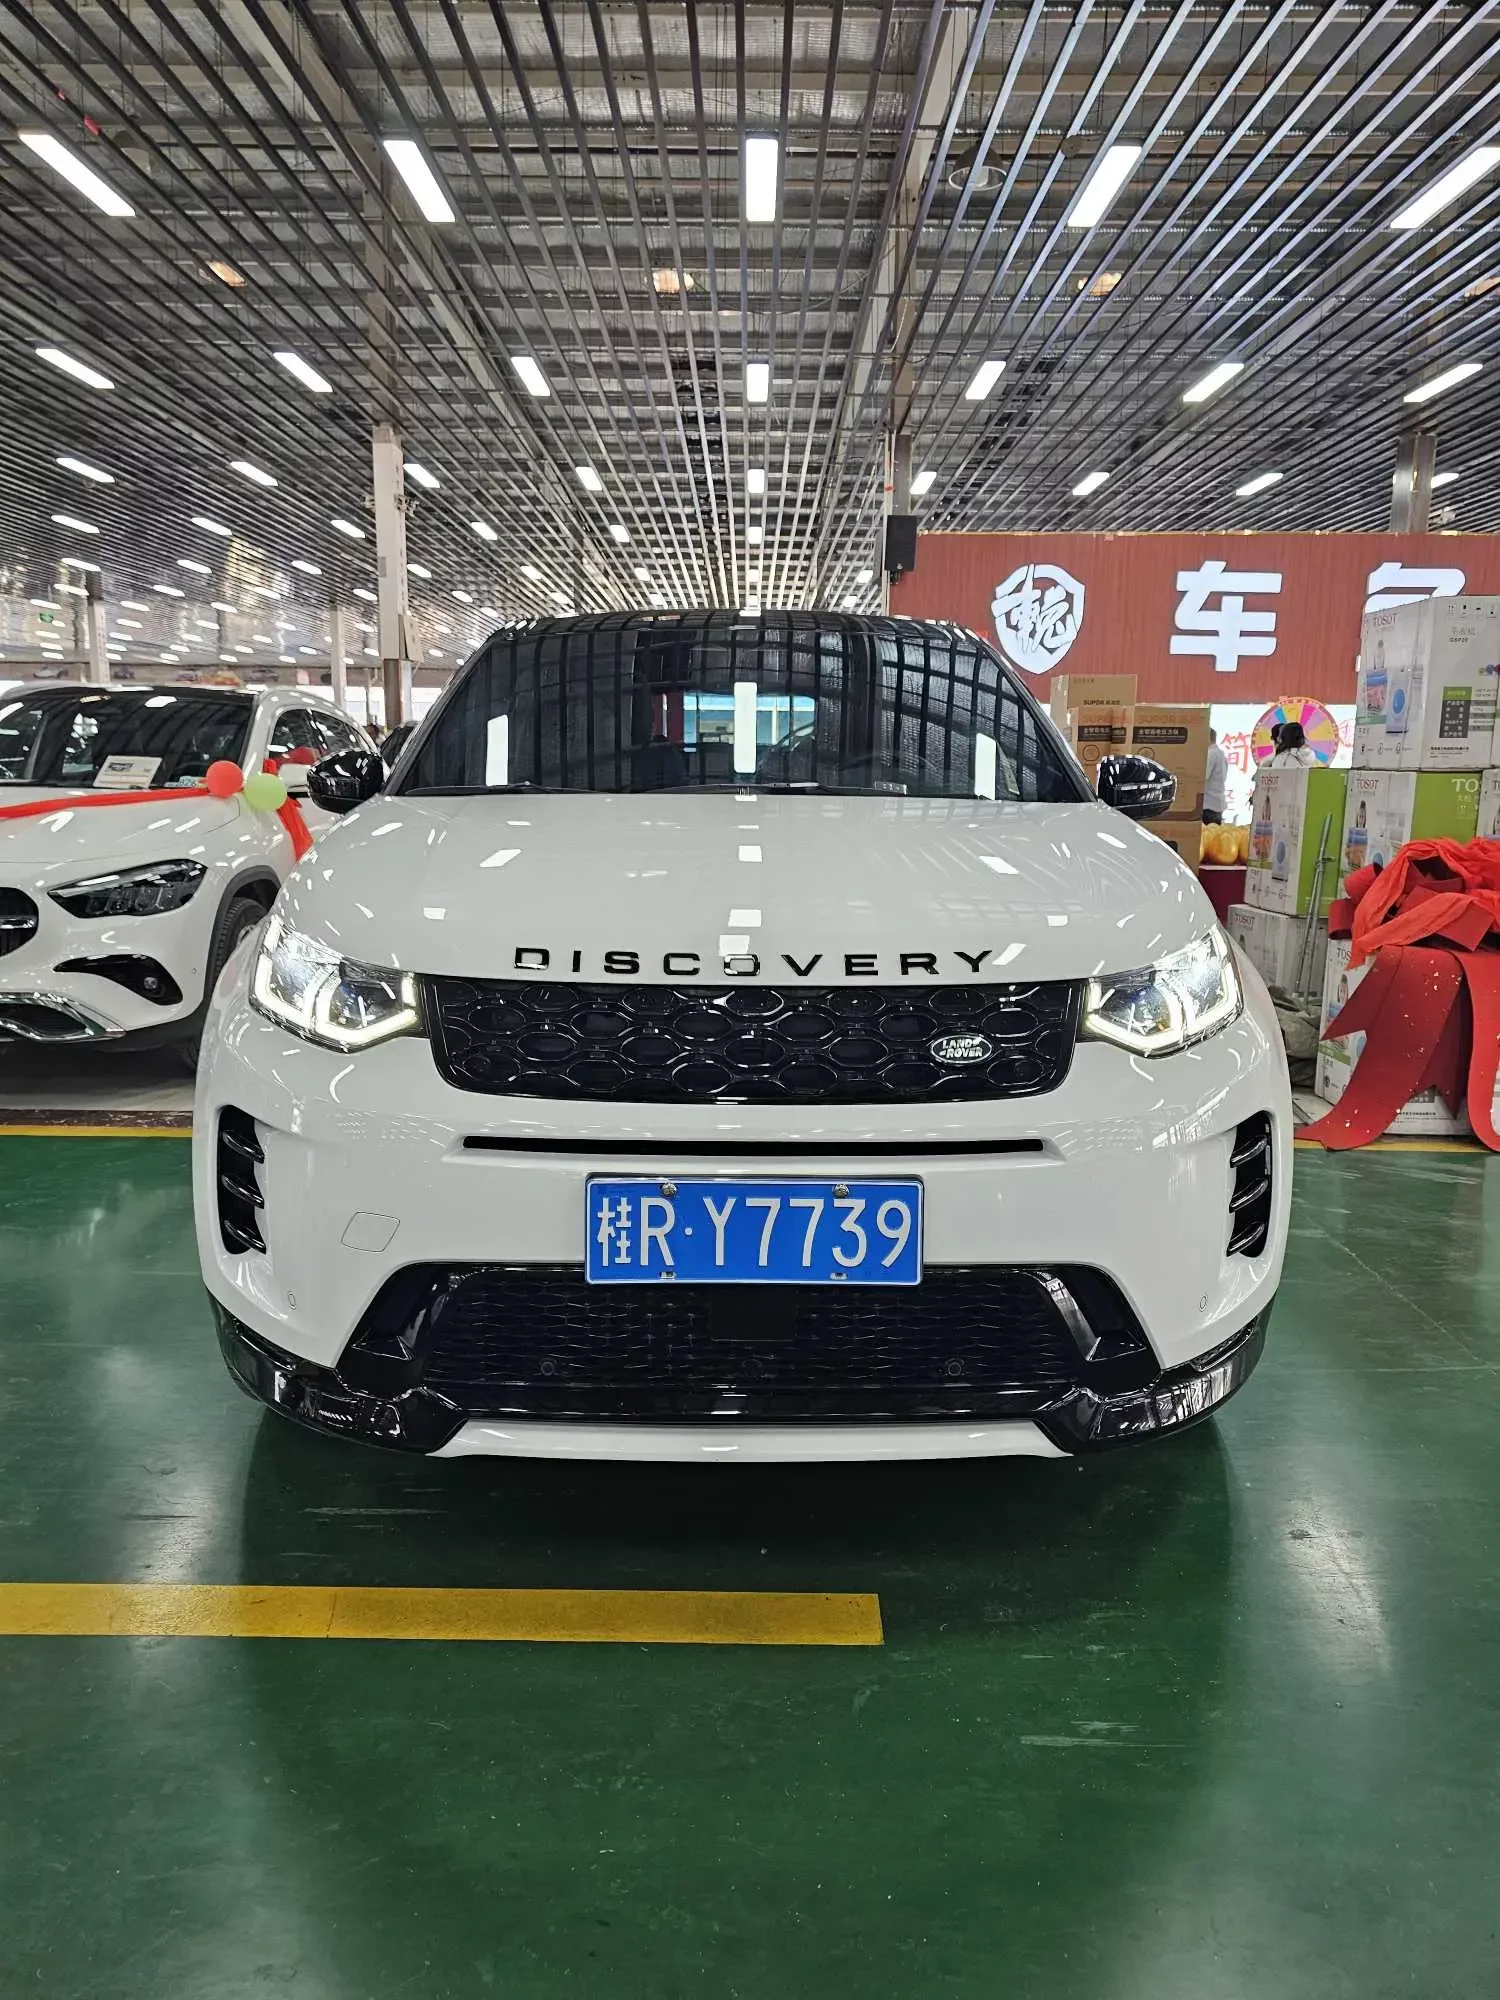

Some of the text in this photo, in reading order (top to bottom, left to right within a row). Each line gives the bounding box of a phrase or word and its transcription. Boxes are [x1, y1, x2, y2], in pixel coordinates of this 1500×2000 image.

[514, 947, 992, 977] DISCOVERY
[943, 1039, 974, 1049] LAND
[946, 1047, 983, 1058] ROVER
